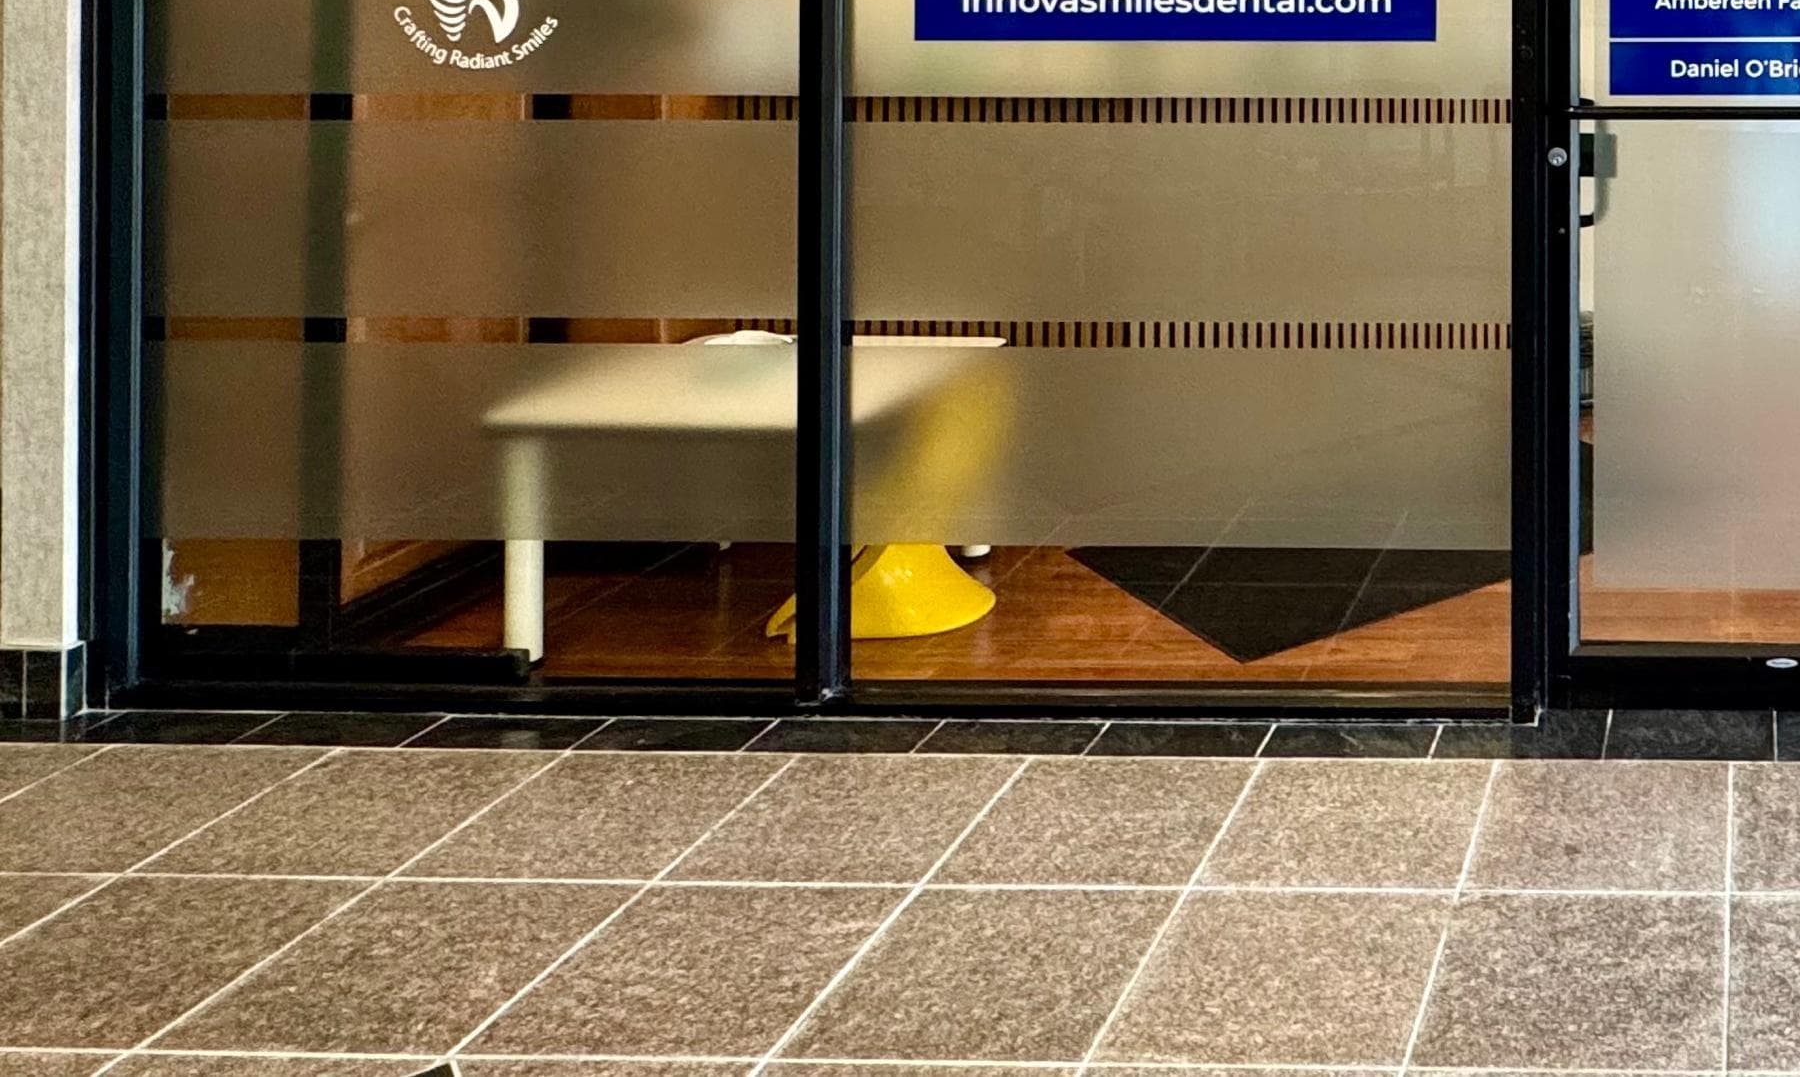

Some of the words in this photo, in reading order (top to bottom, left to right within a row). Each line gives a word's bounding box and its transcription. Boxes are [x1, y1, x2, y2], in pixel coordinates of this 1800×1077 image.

[394, 6, 448, 65] Crafting
[449, 49, 512, 69] Radiant
[511, 16, 559, 61] Smiles
[1671, 58, 1739, 78] Daniel
